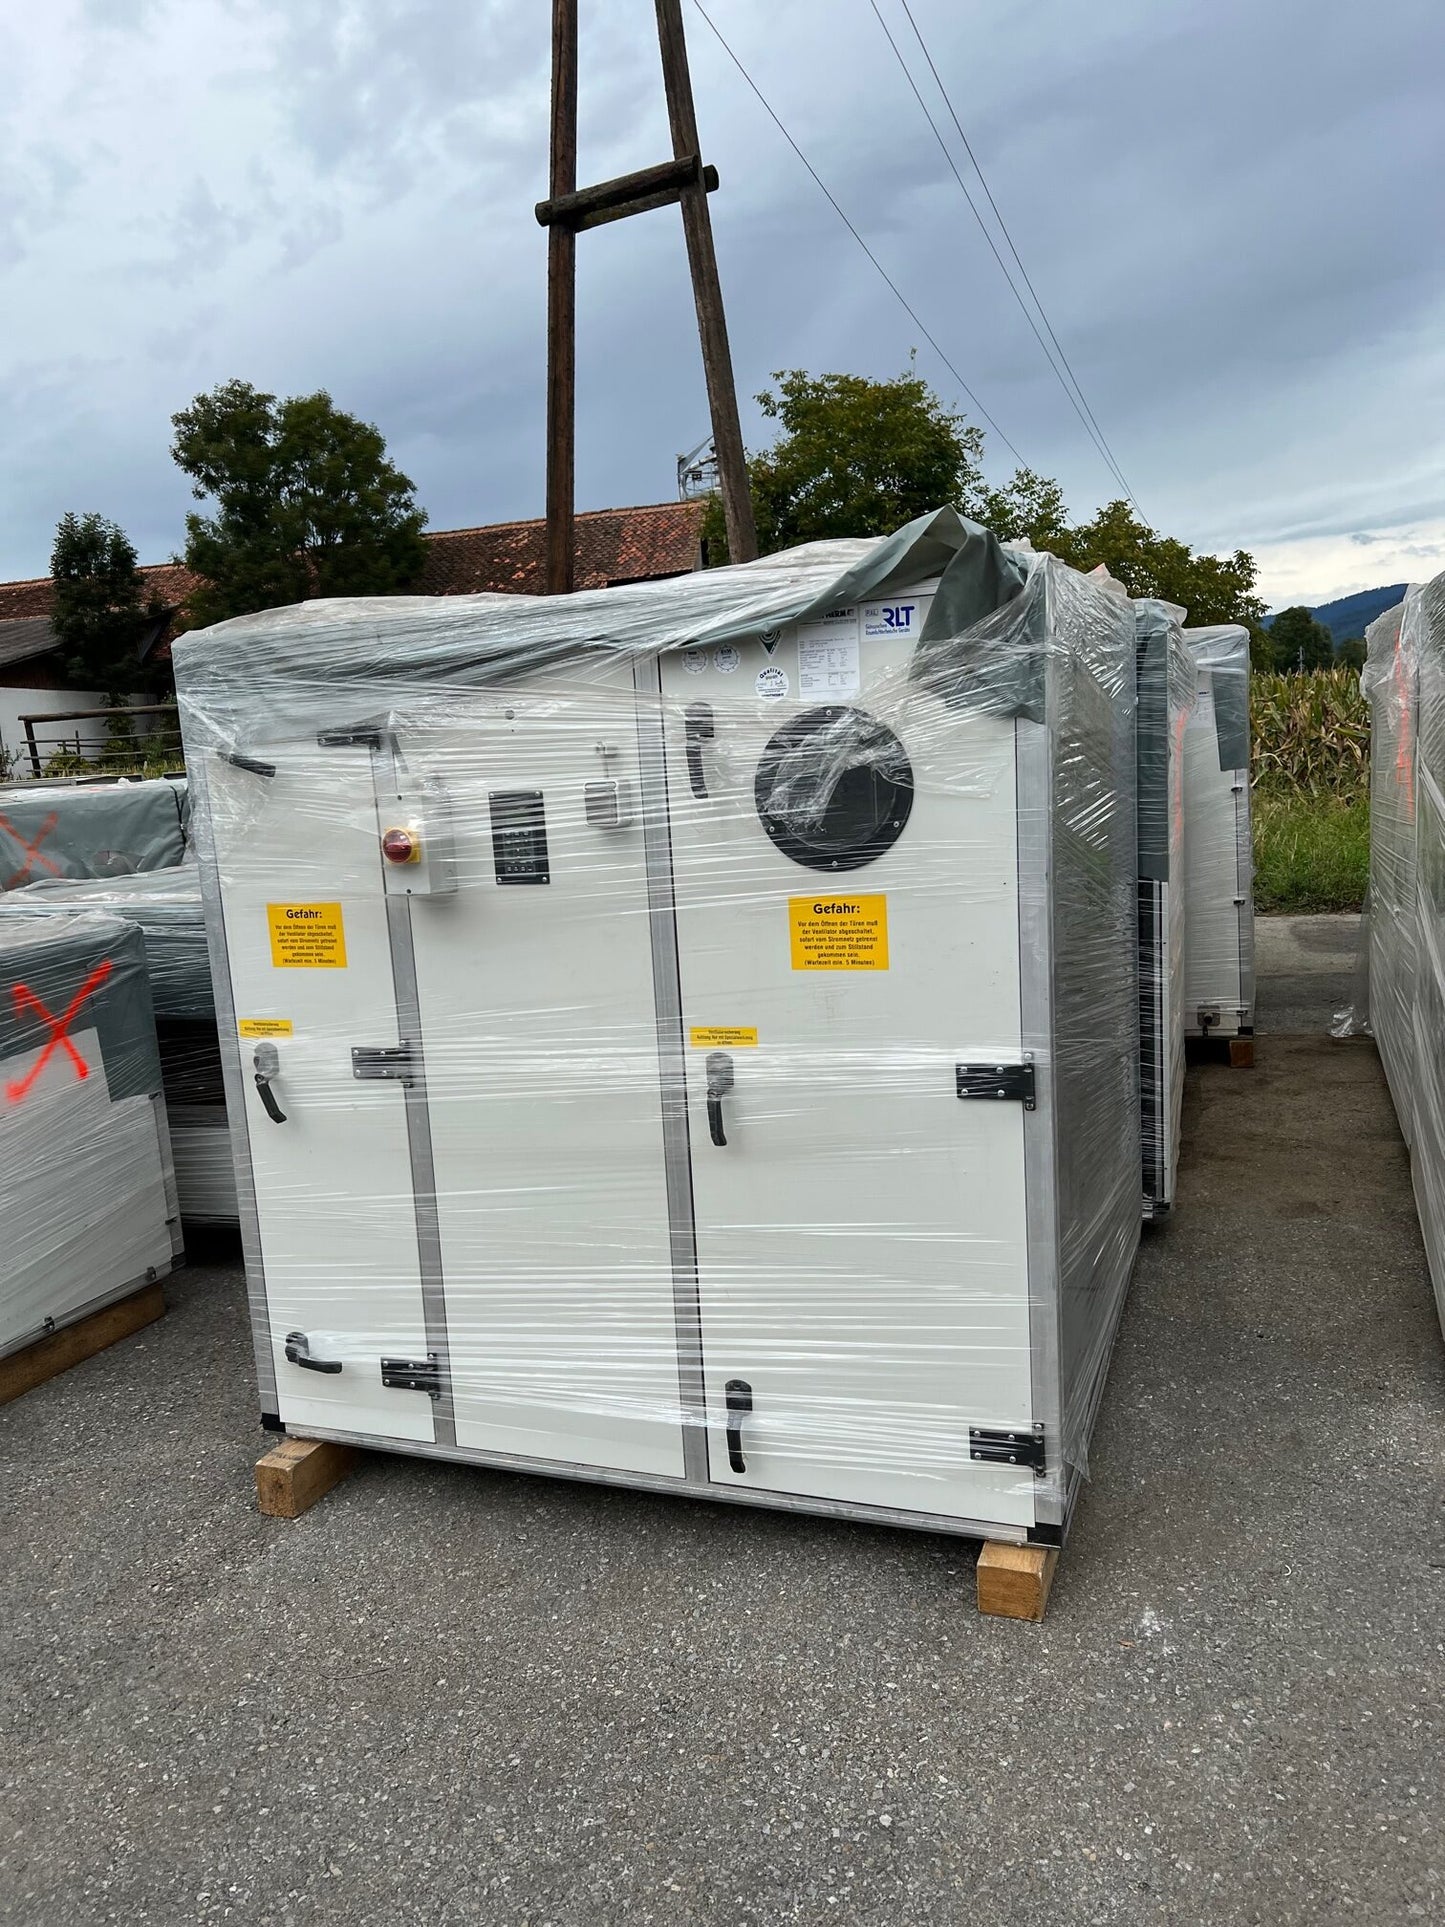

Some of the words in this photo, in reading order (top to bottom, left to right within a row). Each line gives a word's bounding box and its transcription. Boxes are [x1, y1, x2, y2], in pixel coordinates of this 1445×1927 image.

[882, 605, 915, 627] RLT
[286, 909, 322, 919] Gefahr:
[813, 903, 860, 914] Gefahr:
